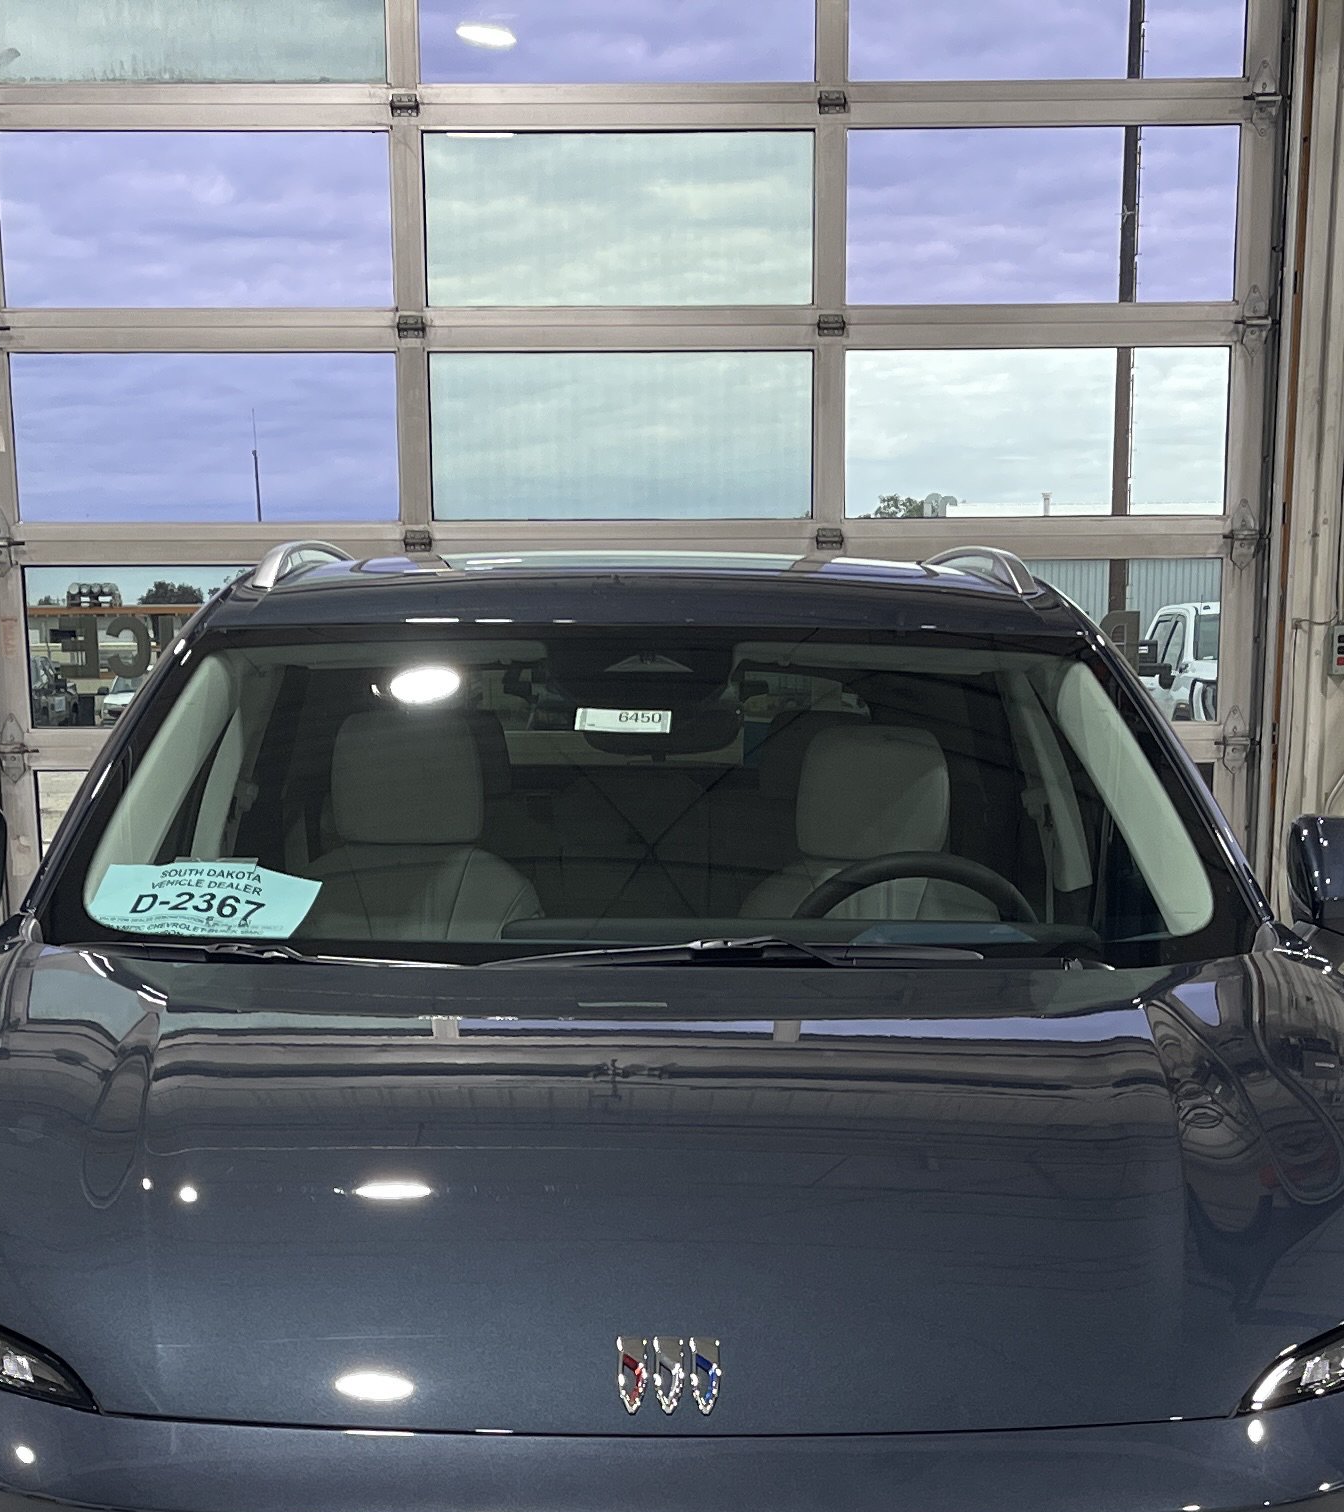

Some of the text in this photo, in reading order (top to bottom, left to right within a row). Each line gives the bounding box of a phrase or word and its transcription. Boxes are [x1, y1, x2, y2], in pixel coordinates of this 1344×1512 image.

[618, 711, 662, 724] 6450
[160, 868, 262, 883] SOUTH DAKOTA
[151, 878, 263, 896] VEHICLE DEALER
[129, 892, 266, 922] D-2367
